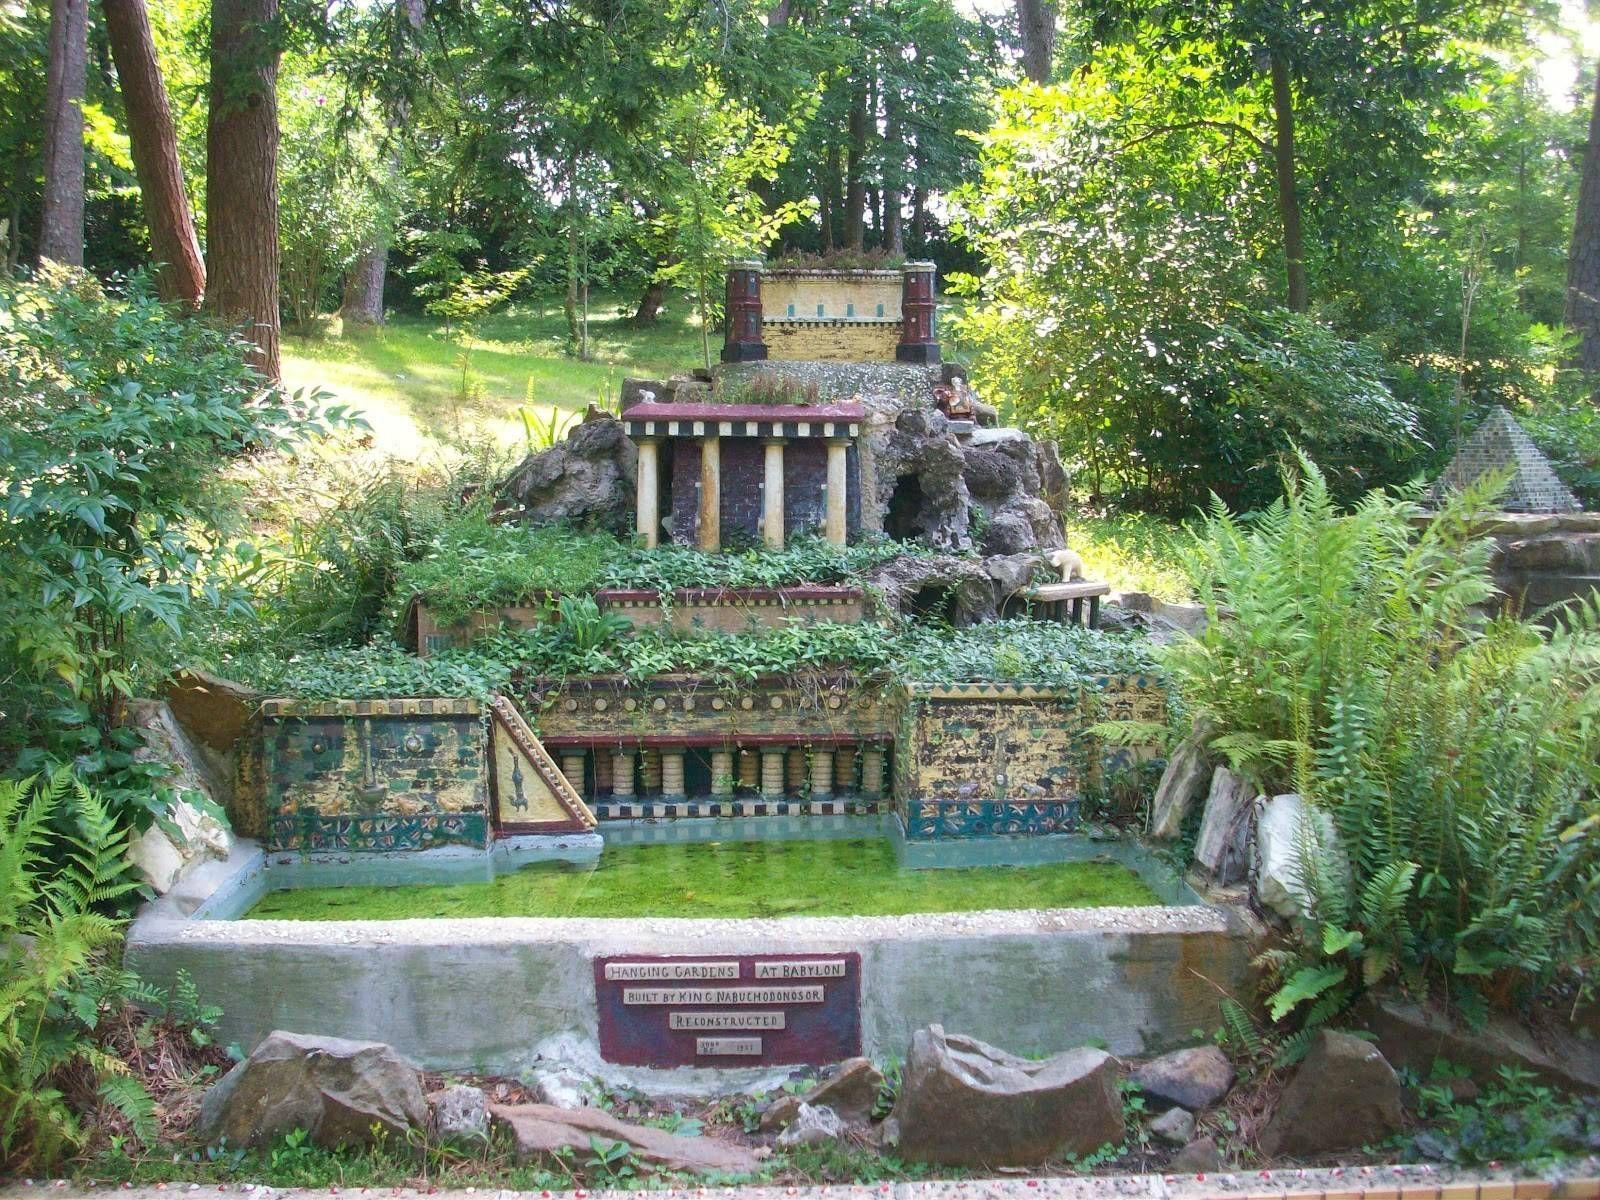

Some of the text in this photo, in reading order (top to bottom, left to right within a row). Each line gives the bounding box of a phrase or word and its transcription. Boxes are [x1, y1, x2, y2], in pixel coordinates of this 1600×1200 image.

[611, 963, 841, 978] HANGING GARDENS AT BABYLON
[628, 992, 658, 1002] BUILT
[663, 993, 675, 1003] BY
[679, 991, 712, 1002] KING
[676, 1015, 778, 1028] RECONSTRUCTED
